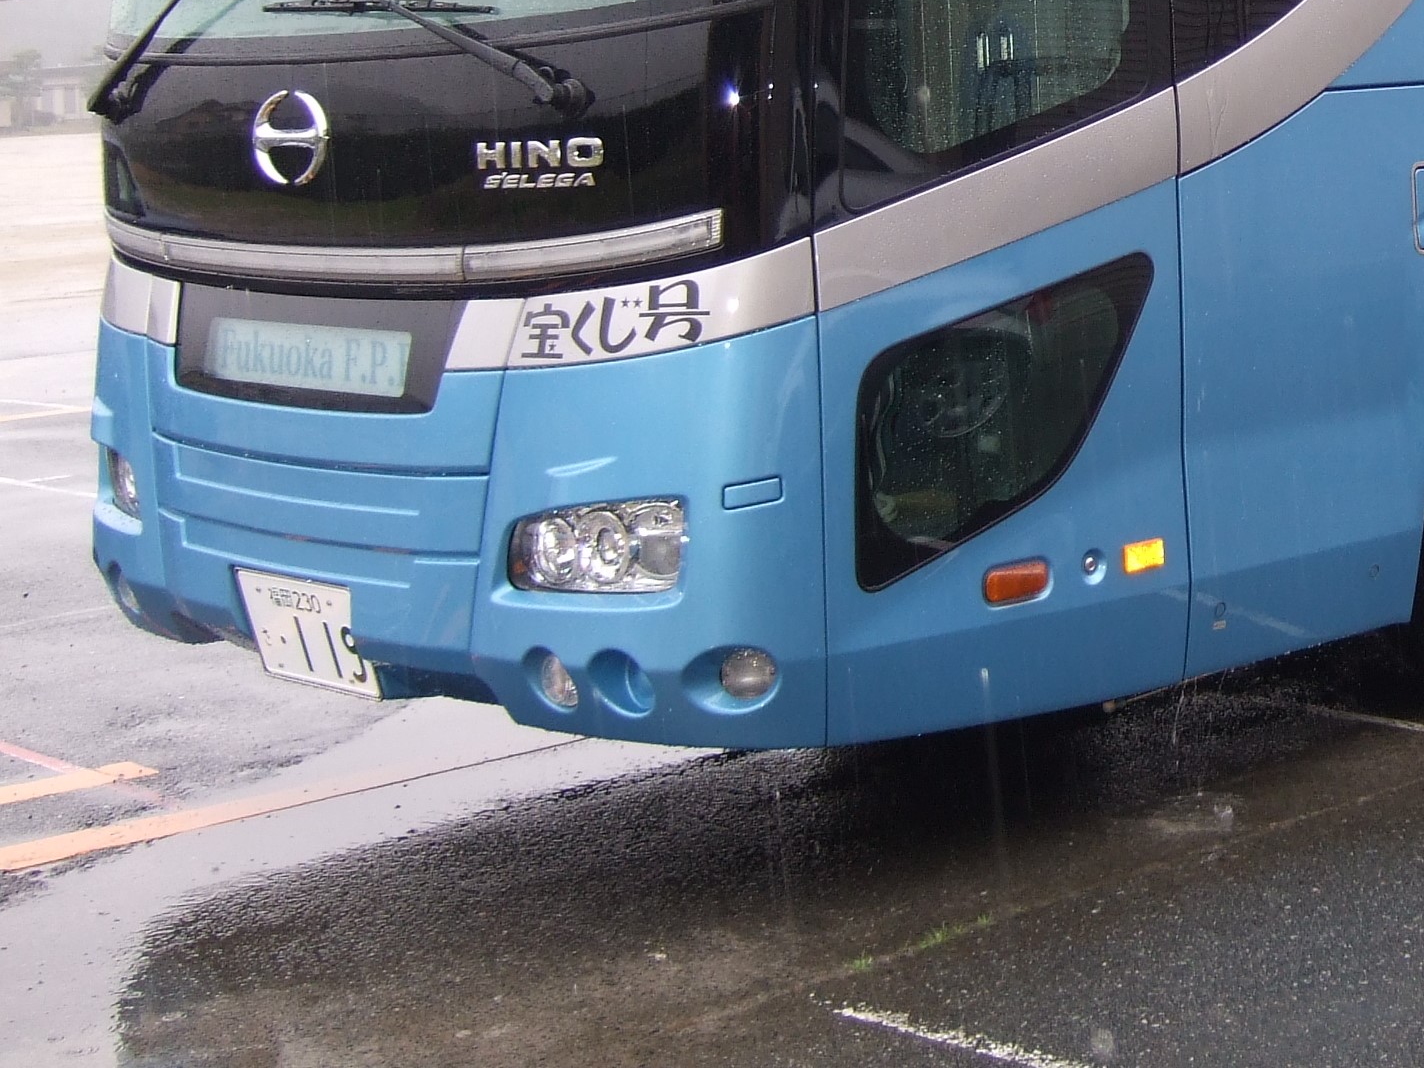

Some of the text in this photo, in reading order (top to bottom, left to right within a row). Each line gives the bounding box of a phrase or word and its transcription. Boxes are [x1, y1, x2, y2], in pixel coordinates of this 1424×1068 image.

[476, 136, 604, 170] HINO
[483, 171, 597, 189] SELEGA
[521, 279, 711, 359] 宝くじ号
[220, 327, 333, 380] Fukuoka
